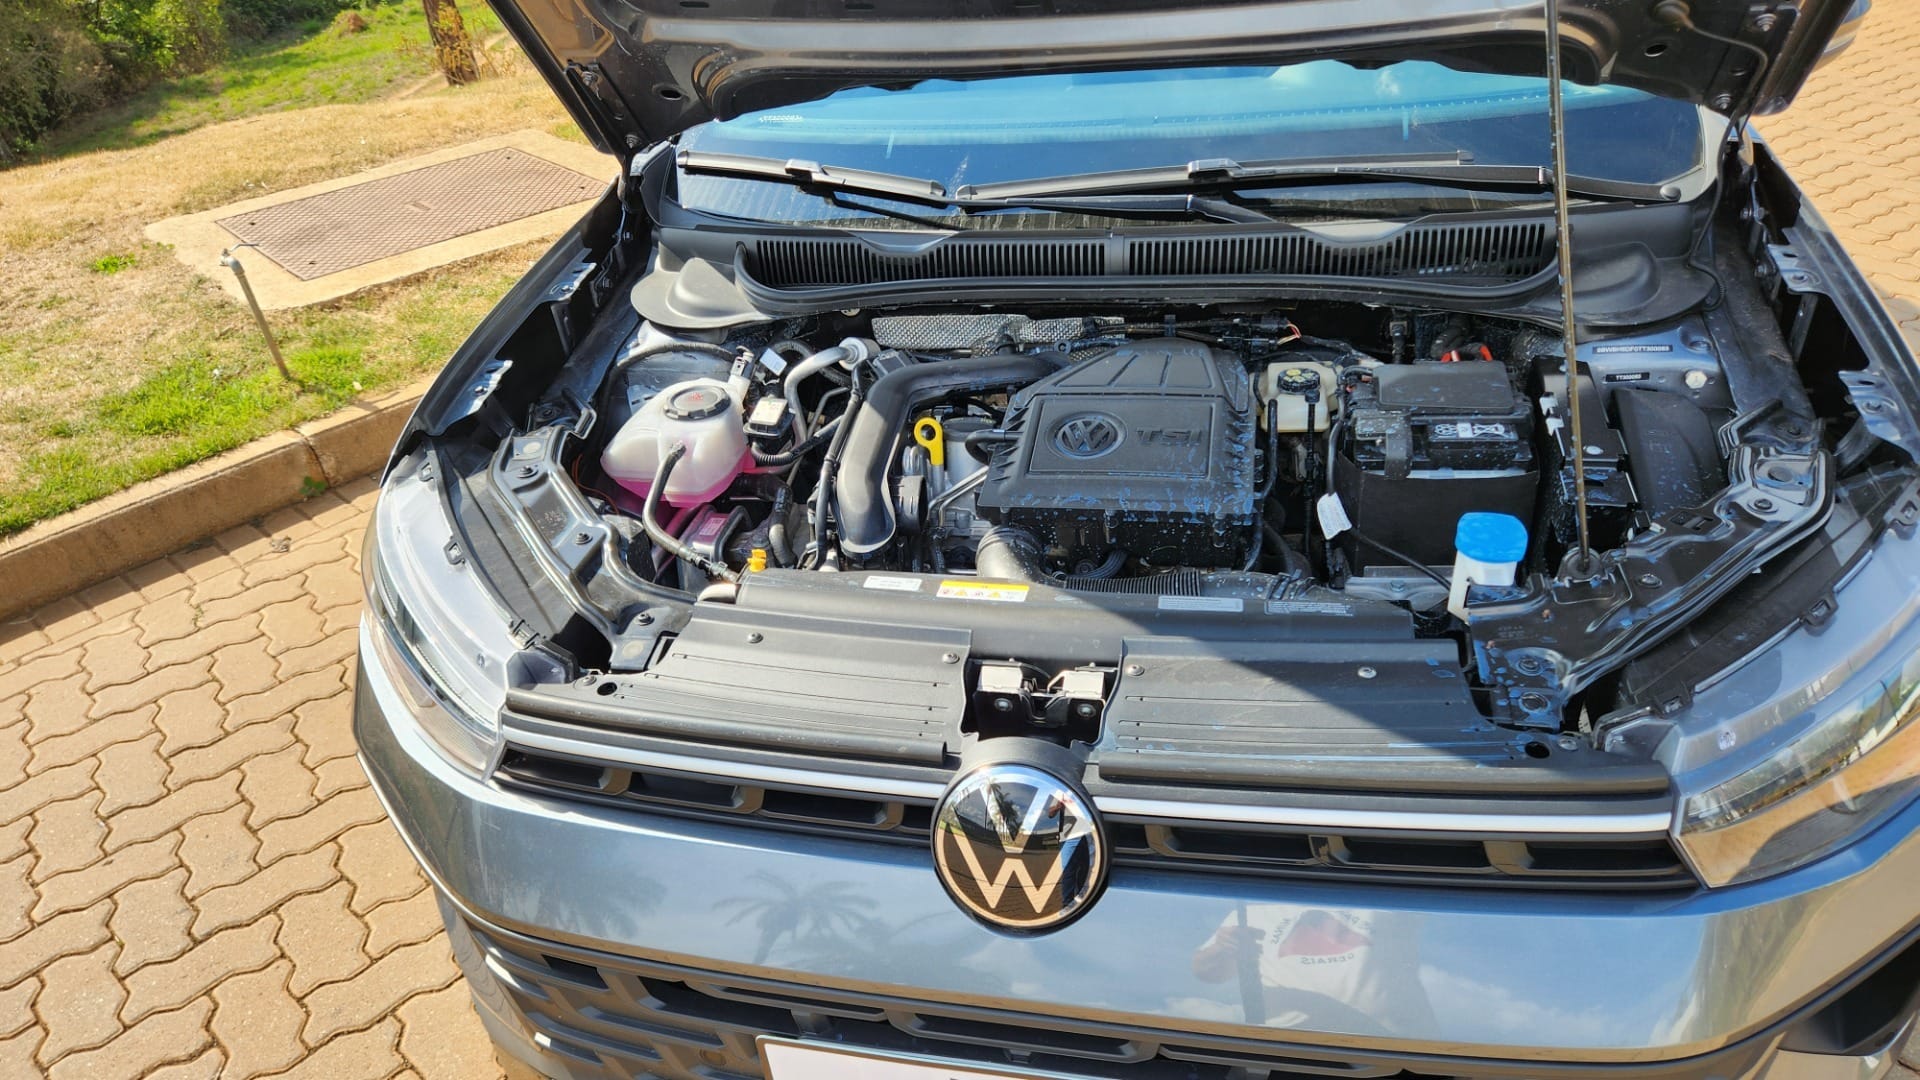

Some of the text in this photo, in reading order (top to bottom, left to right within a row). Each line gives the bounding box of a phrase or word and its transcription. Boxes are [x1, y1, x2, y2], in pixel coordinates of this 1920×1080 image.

[1056, 415, 1119, 458] VW
[1136, 426, 1202, 446] TSI
[939, 767, 1099, 923] VW
